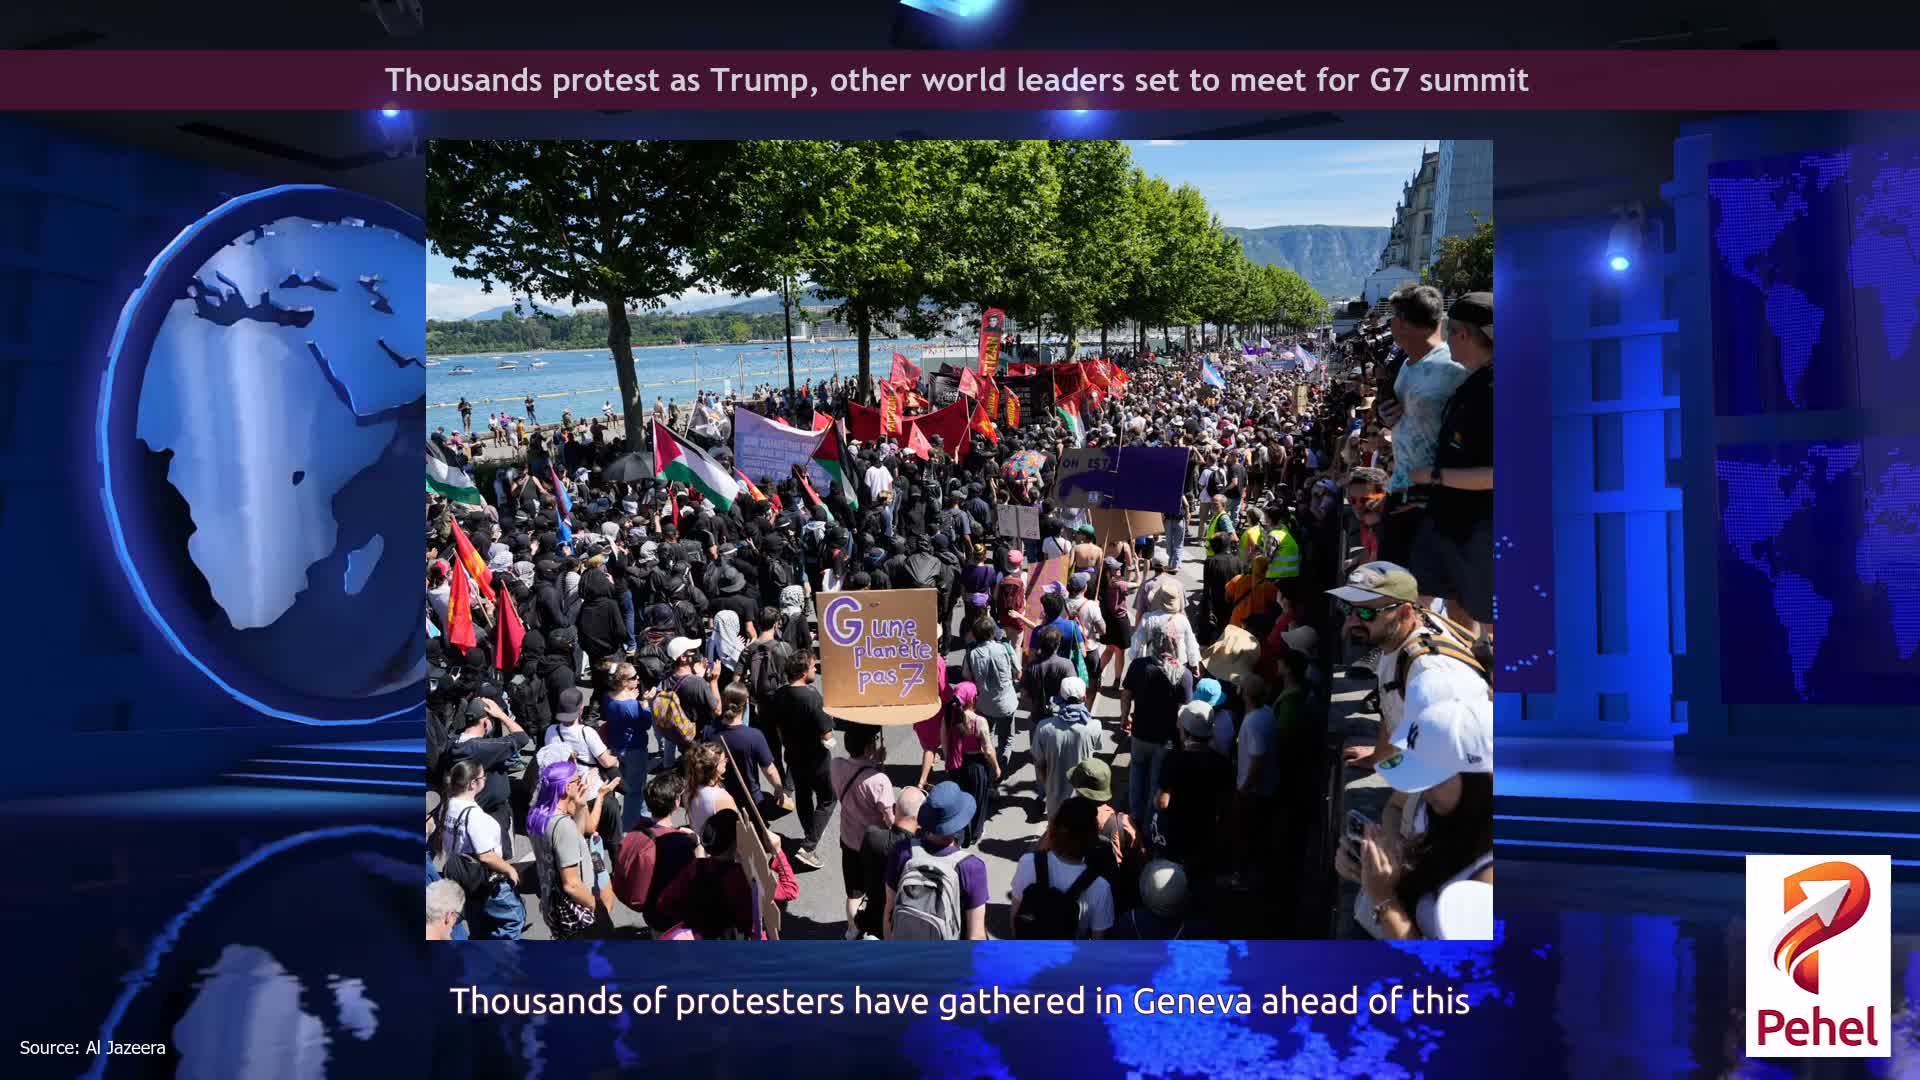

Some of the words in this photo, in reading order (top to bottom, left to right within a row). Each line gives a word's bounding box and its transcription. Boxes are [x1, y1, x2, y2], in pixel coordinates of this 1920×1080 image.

[1063, 456, 1079, 469] ON
[823, 595, 864, 647] G
[872, 619, 917, 637] une
[853, 637, 933, 669] planète
[857, 669, 898, 695] pas
[898, 662, 926, 698] 7
